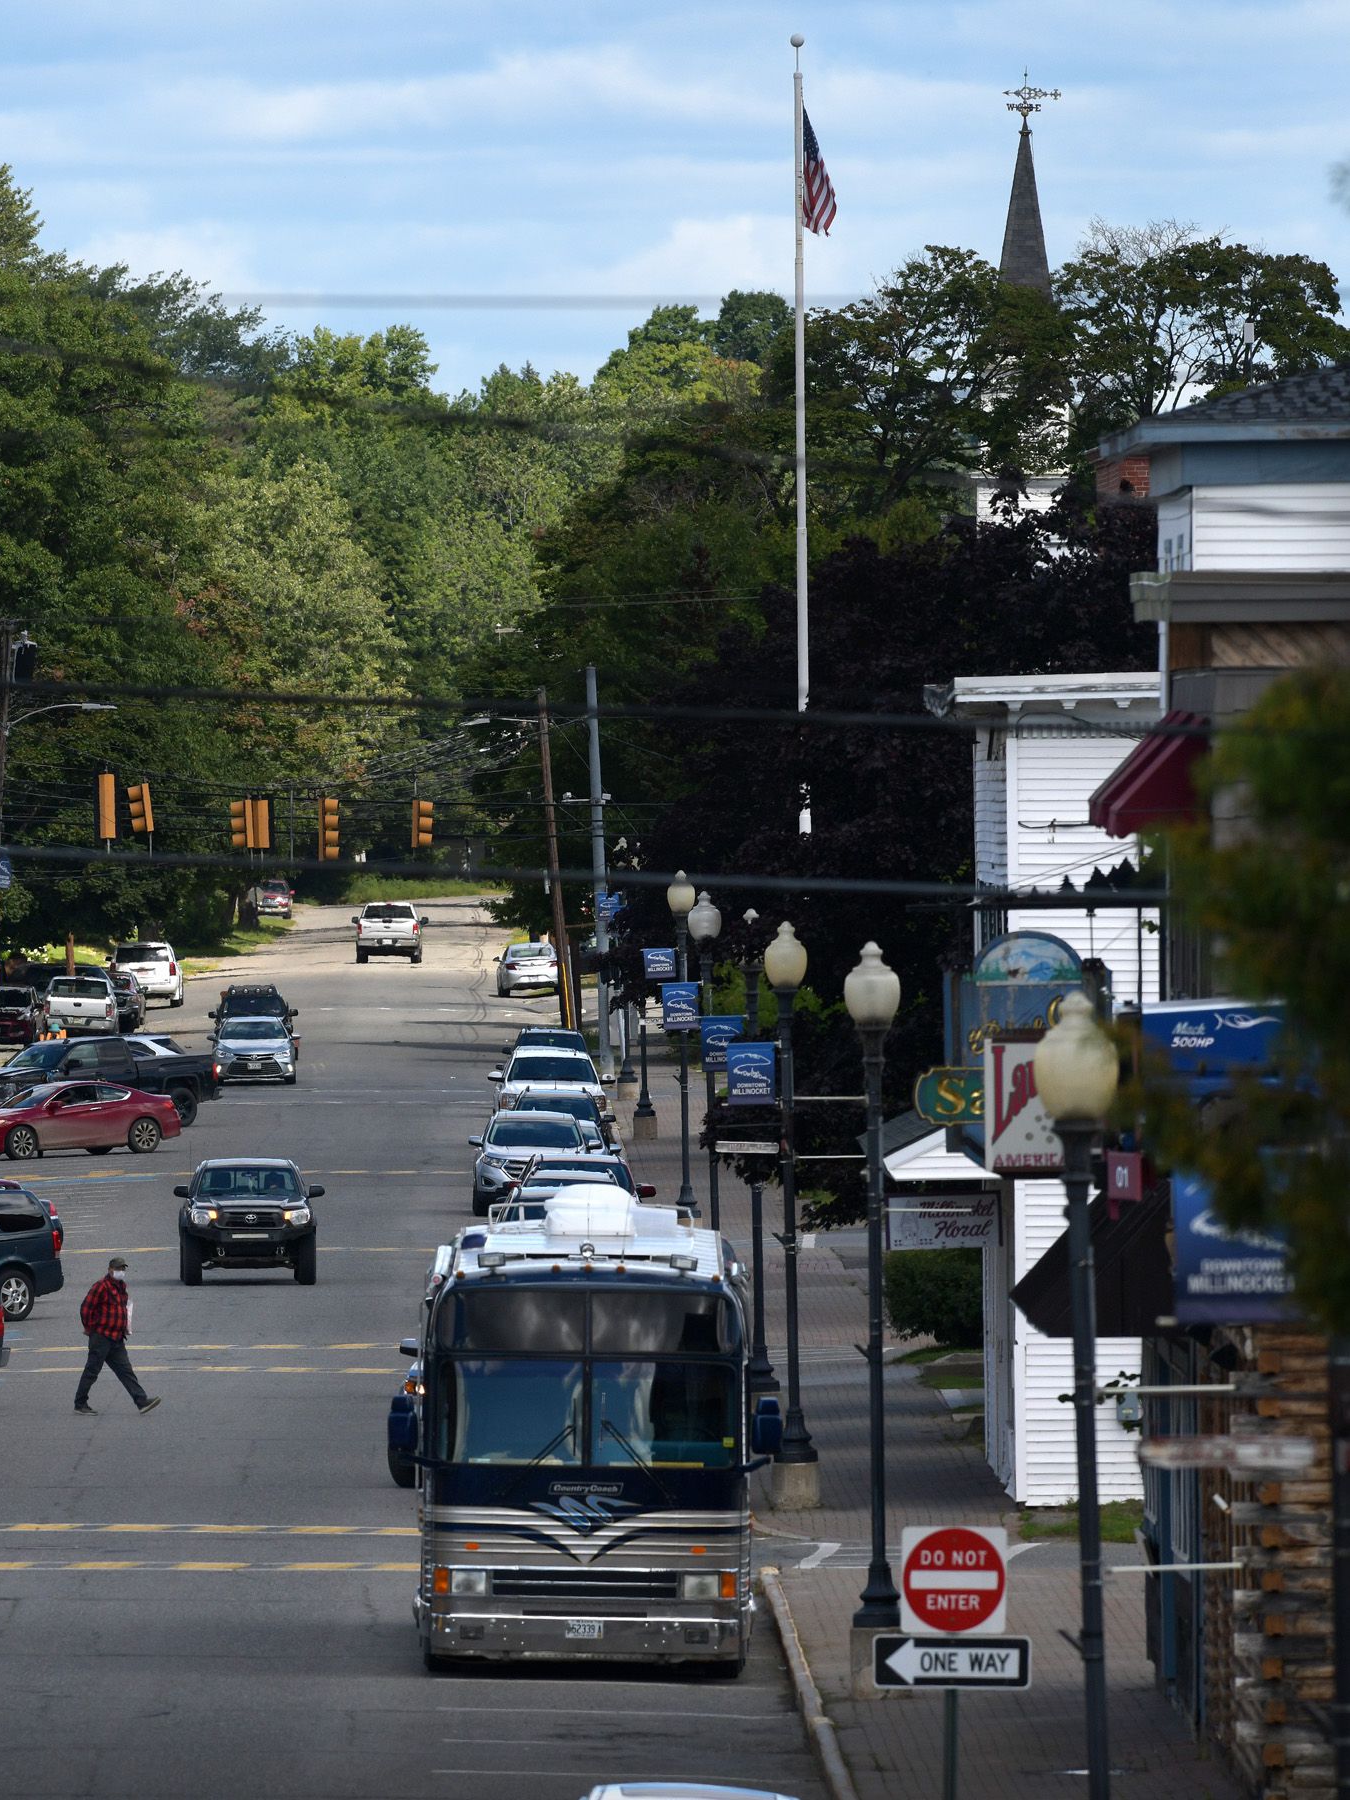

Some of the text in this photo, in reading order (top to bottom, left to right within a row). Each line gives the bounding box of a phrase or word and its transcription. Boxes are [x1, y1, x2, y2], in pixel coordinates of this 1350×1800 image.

[1171, 1036, 1215, 1048] 500HP
[732, 1087, 771, 1095] MILLINOCKET
[934, 1219, 993, 1239] Floral
[920, 1550, 987, 1566] DO NOT
[926, 1595, 980, 1610] ENTER
[920, 1652, 1010, 1673] ONE WAY
